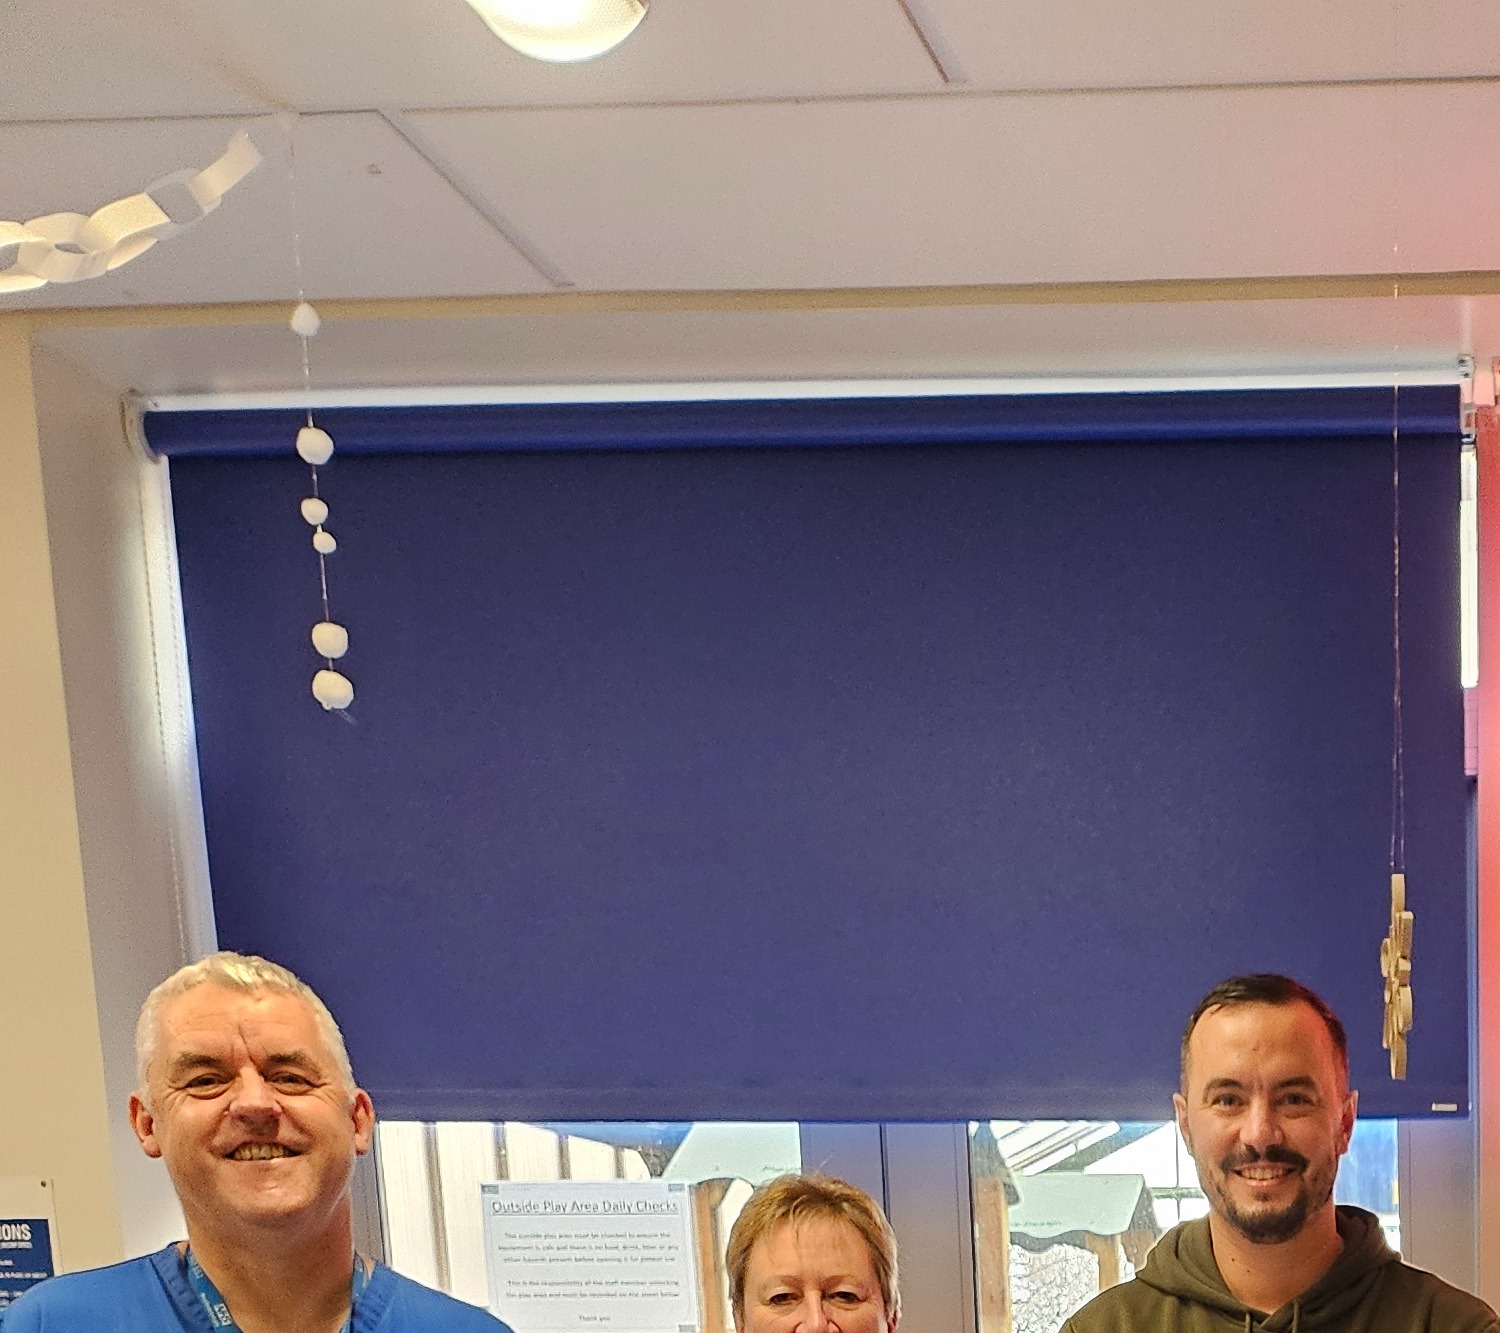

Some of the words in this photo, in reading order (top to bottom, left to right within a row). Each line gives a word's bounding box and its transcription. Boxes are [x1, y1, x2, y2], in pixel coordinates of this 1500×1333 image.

[492, 1201, 540, 1214] Outside
[543, 1201, 567, 1213] Play
[571, 1201, 599, 1212] Area
[602, 1200, 632, 1213] Daily
[636, 1200, 679, 1213] Checks
